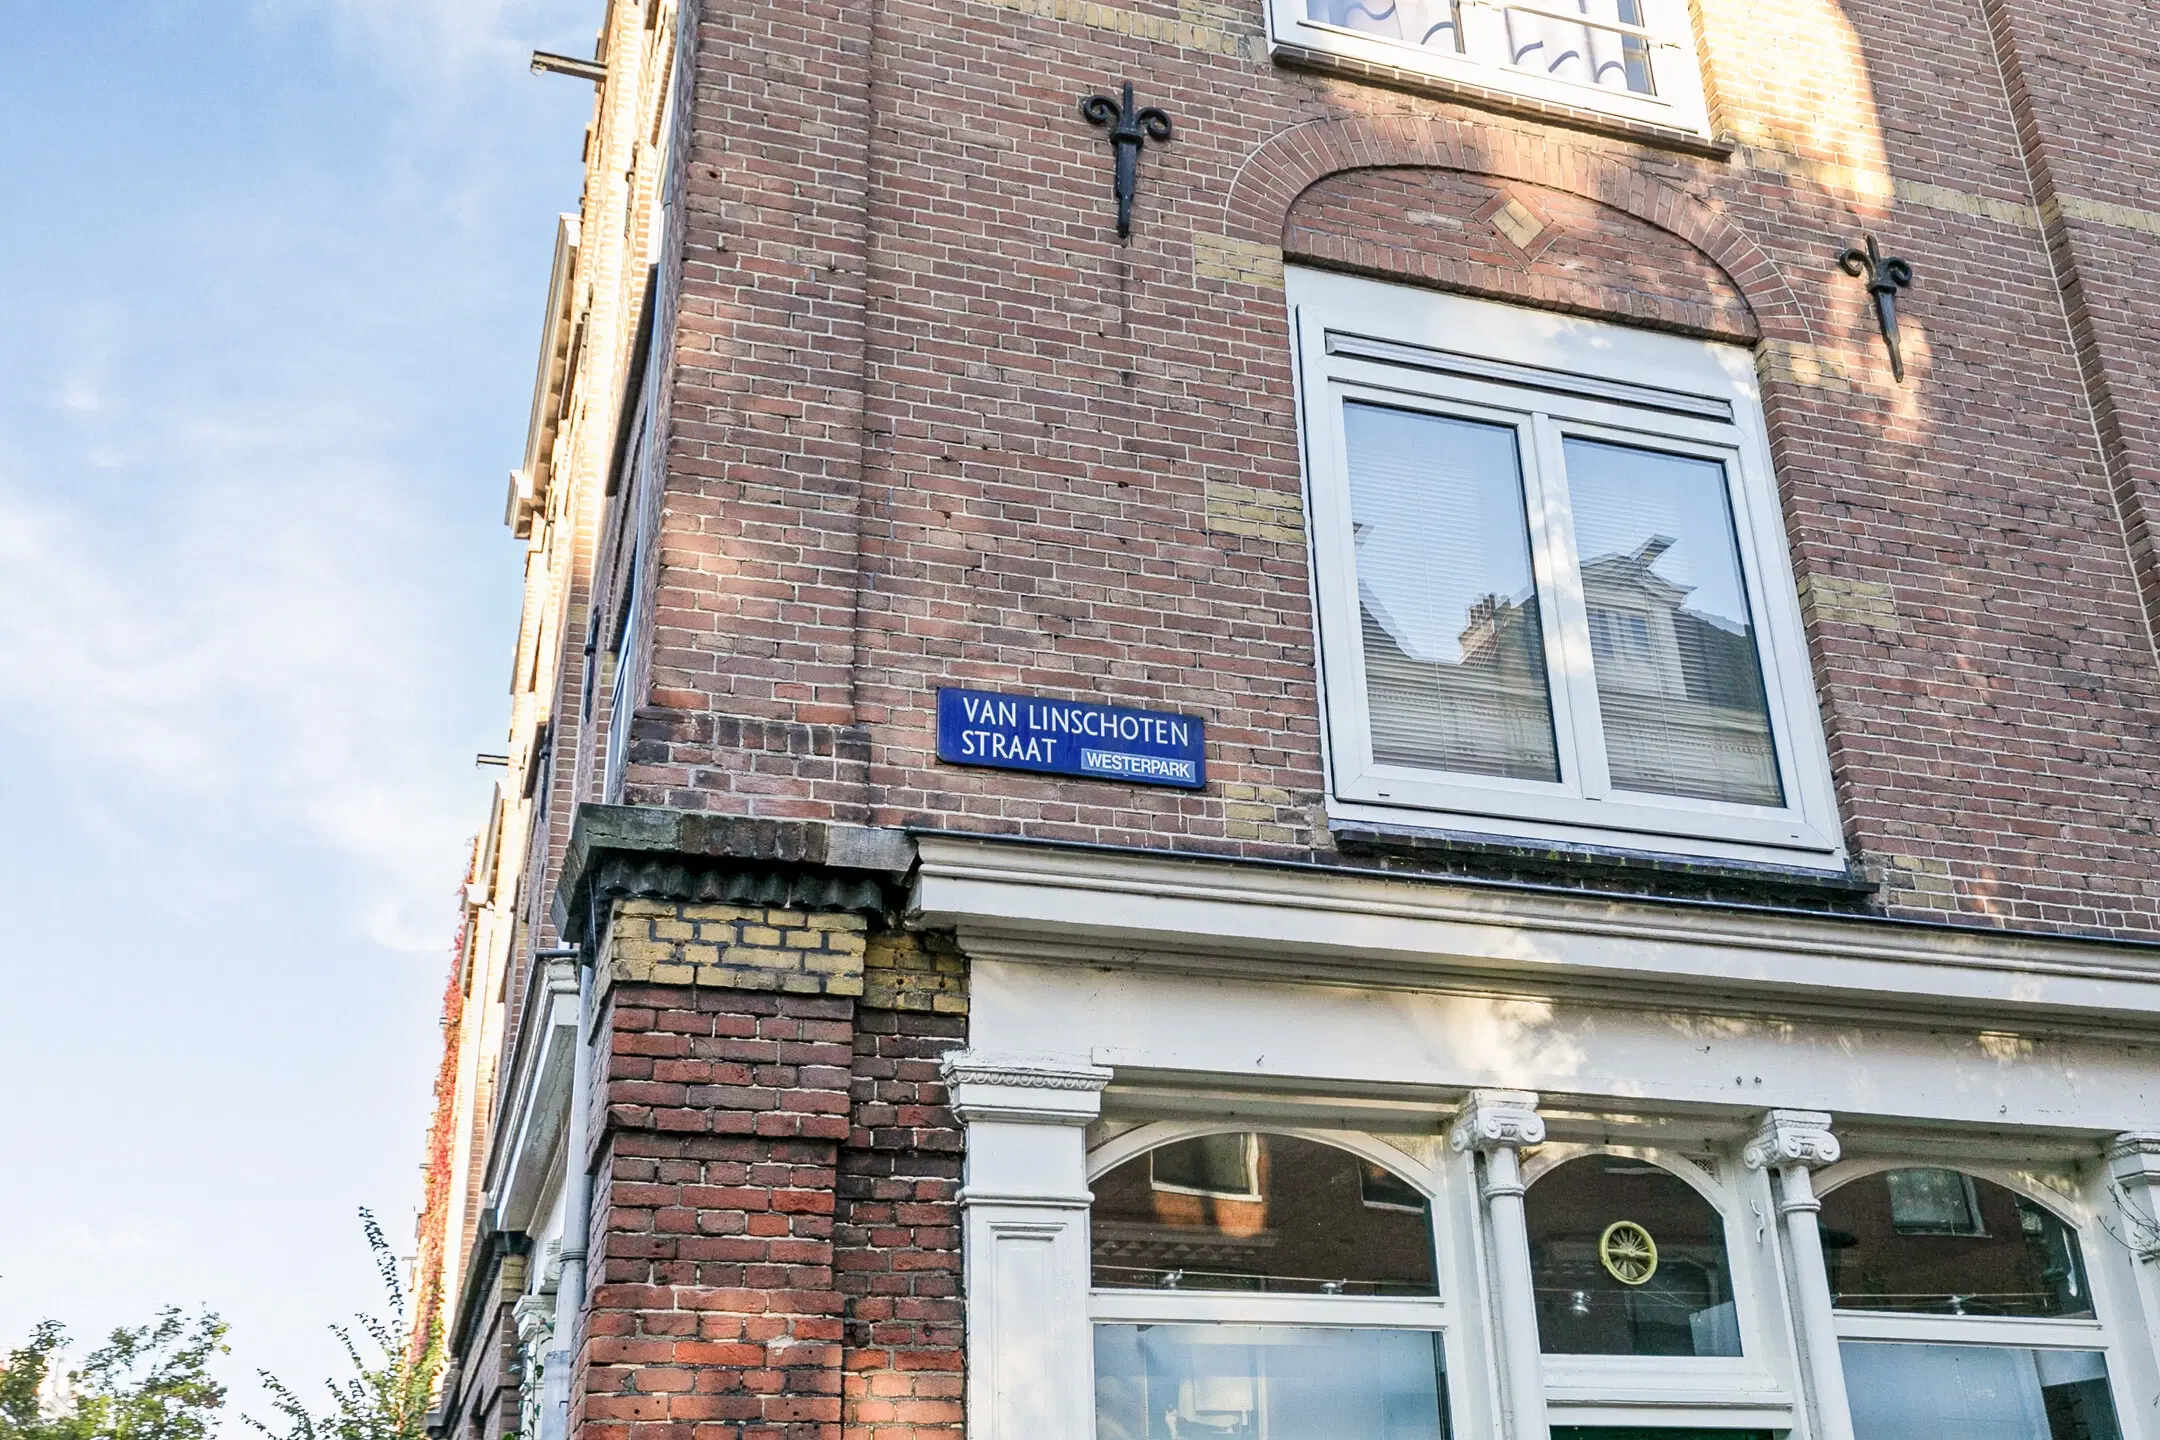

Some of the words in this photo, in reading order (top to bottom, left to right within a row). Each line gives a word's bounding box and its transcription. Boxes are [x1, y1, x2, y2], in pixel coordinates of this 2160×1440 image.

[962, 697, 1016, 727] VAN
[1029, 704, 1188, 747] LINSCHOTEN
[961, 729, 1057, 763] STRAAT
[1086, 751, 1191, 779] WESTERPARK
